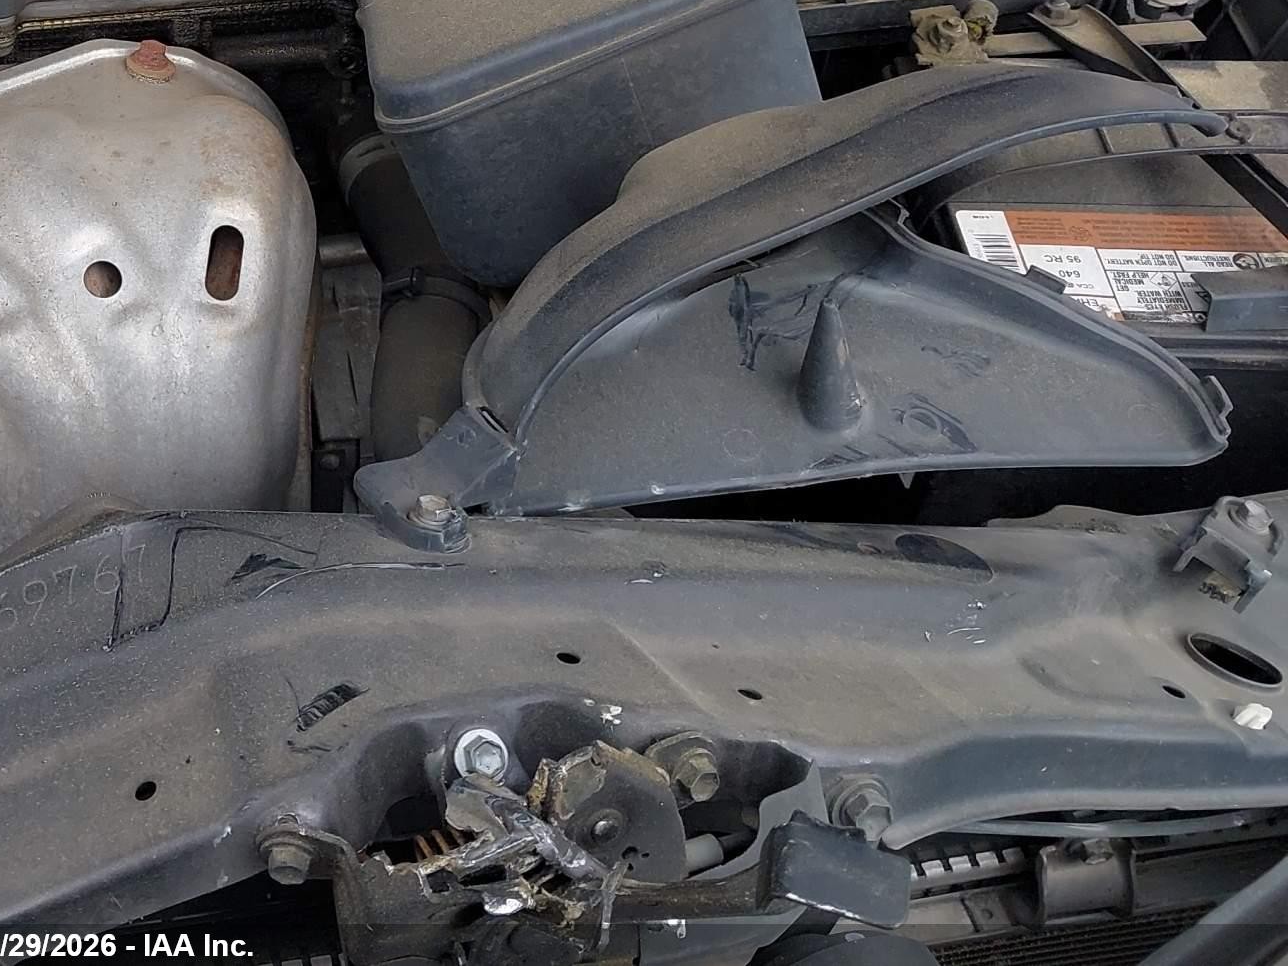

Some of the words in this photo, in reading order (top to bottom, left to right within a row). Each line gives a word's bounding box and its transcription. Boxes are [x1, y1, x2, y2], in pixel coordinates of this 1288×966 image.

[1043, 254, 1063, 263] RC
[1066, 254, 1082, 263] 95
[1058, 269, 1081, 278] 640
